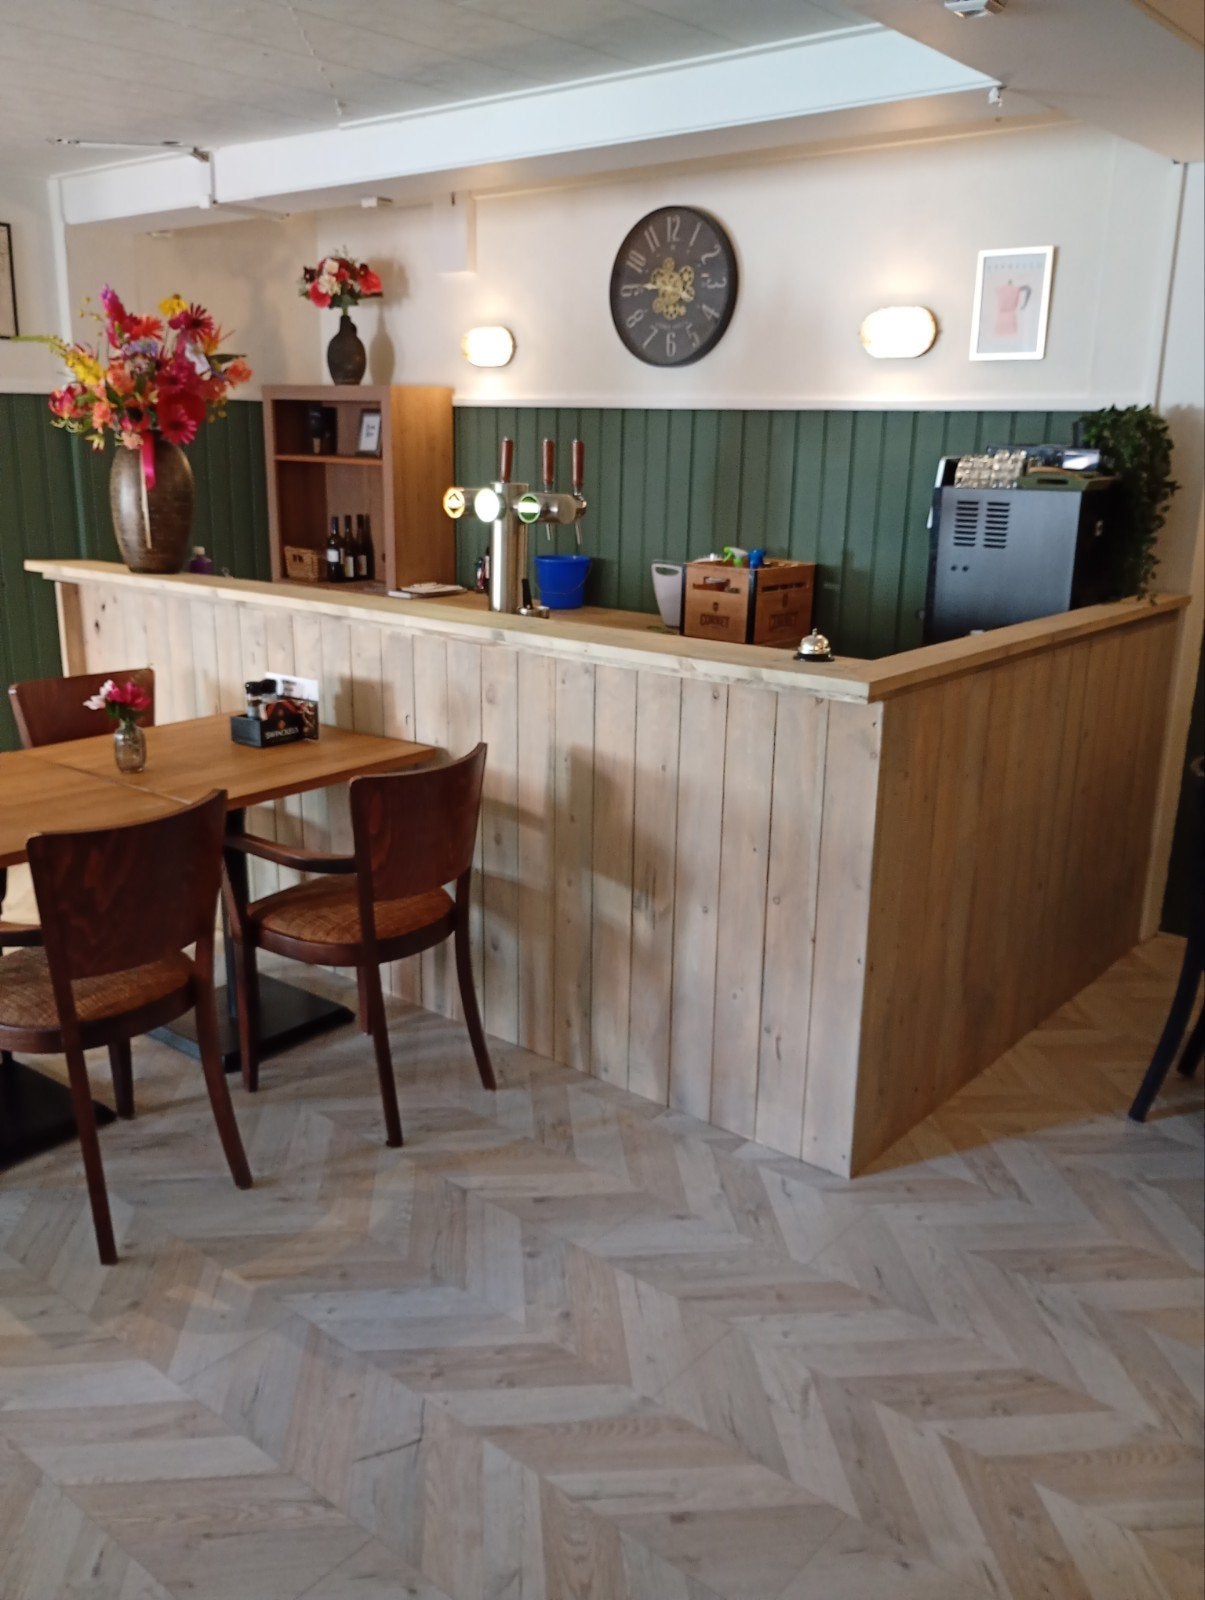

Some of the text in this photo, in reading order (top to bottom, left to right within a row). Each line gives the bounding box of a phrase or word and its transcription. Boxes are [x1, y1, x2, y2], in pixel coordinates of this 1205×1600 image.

[644, 225, 660, 252] 11
[667, 215, 681, 242] 12
[689, 222, 701, 247] 1
[626, 250, 647, 274] 10
[701, 244, 722, 265] 2
[620, 284, 643, 298] 9
[626, 308, 644, 328] 8
[702, 304, 720, 320] 4
[642, 326, 658, 349] 7
[666, 332, 676, 357] 6
[685, 322, 700, 348] 5
